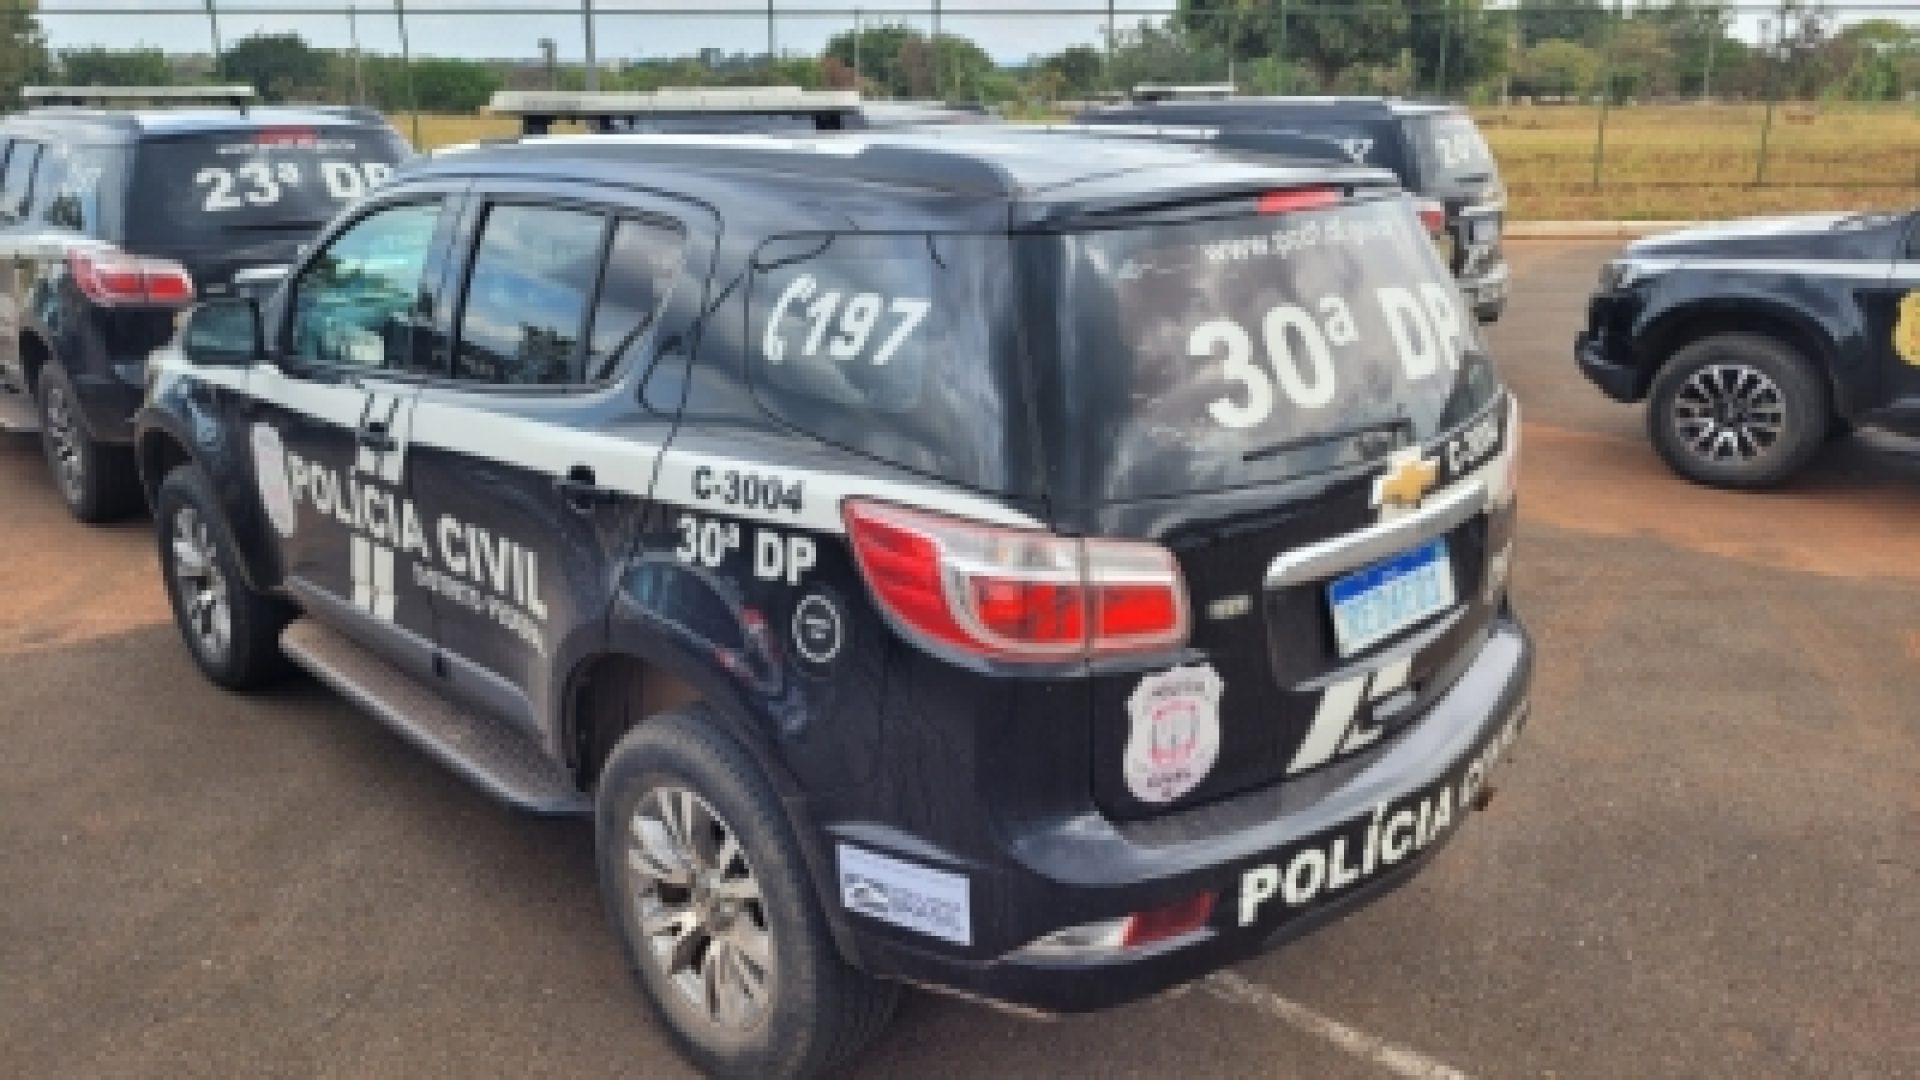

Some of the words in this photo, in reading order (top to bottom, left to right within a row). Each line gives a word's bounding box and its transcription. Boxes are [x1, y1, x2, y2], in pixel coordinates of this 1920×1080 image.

[802, 287, 932, 366] 197
[1376, 281, 1461, 381] DP
[690, 465, 807, 514] C-3004
[436, 512, 549, 621] CIVIL
[753, 529, 818, 587] DP
[1237, 785, 1451, 928] POLÍCIA
